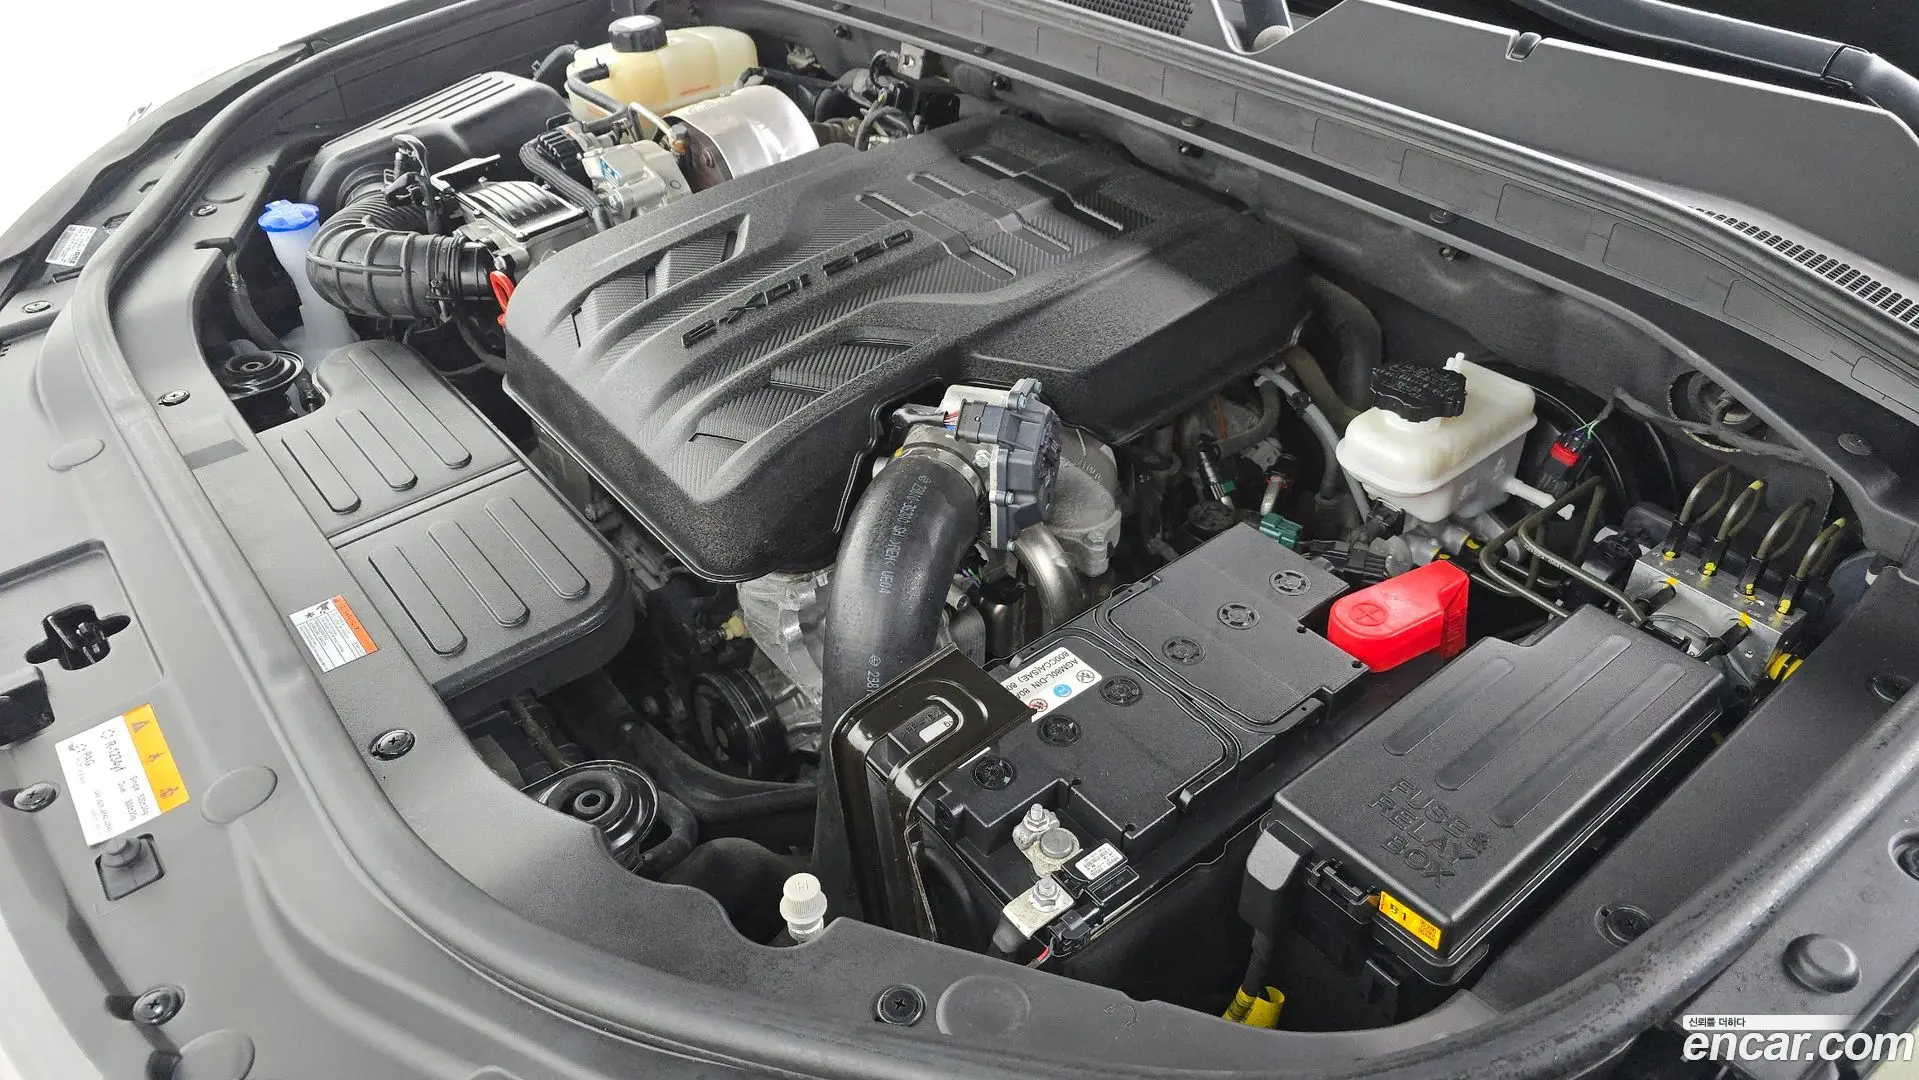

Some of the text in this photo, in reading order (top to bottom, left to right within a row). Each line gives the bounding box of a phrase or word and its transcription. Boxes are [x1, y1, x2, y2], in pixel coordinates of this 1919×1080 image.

[1369, 792, 1475, 864] RELAY
[1388, 778, 1471, 838] FUSE
[1381, 833, 1454, 889] BOX
